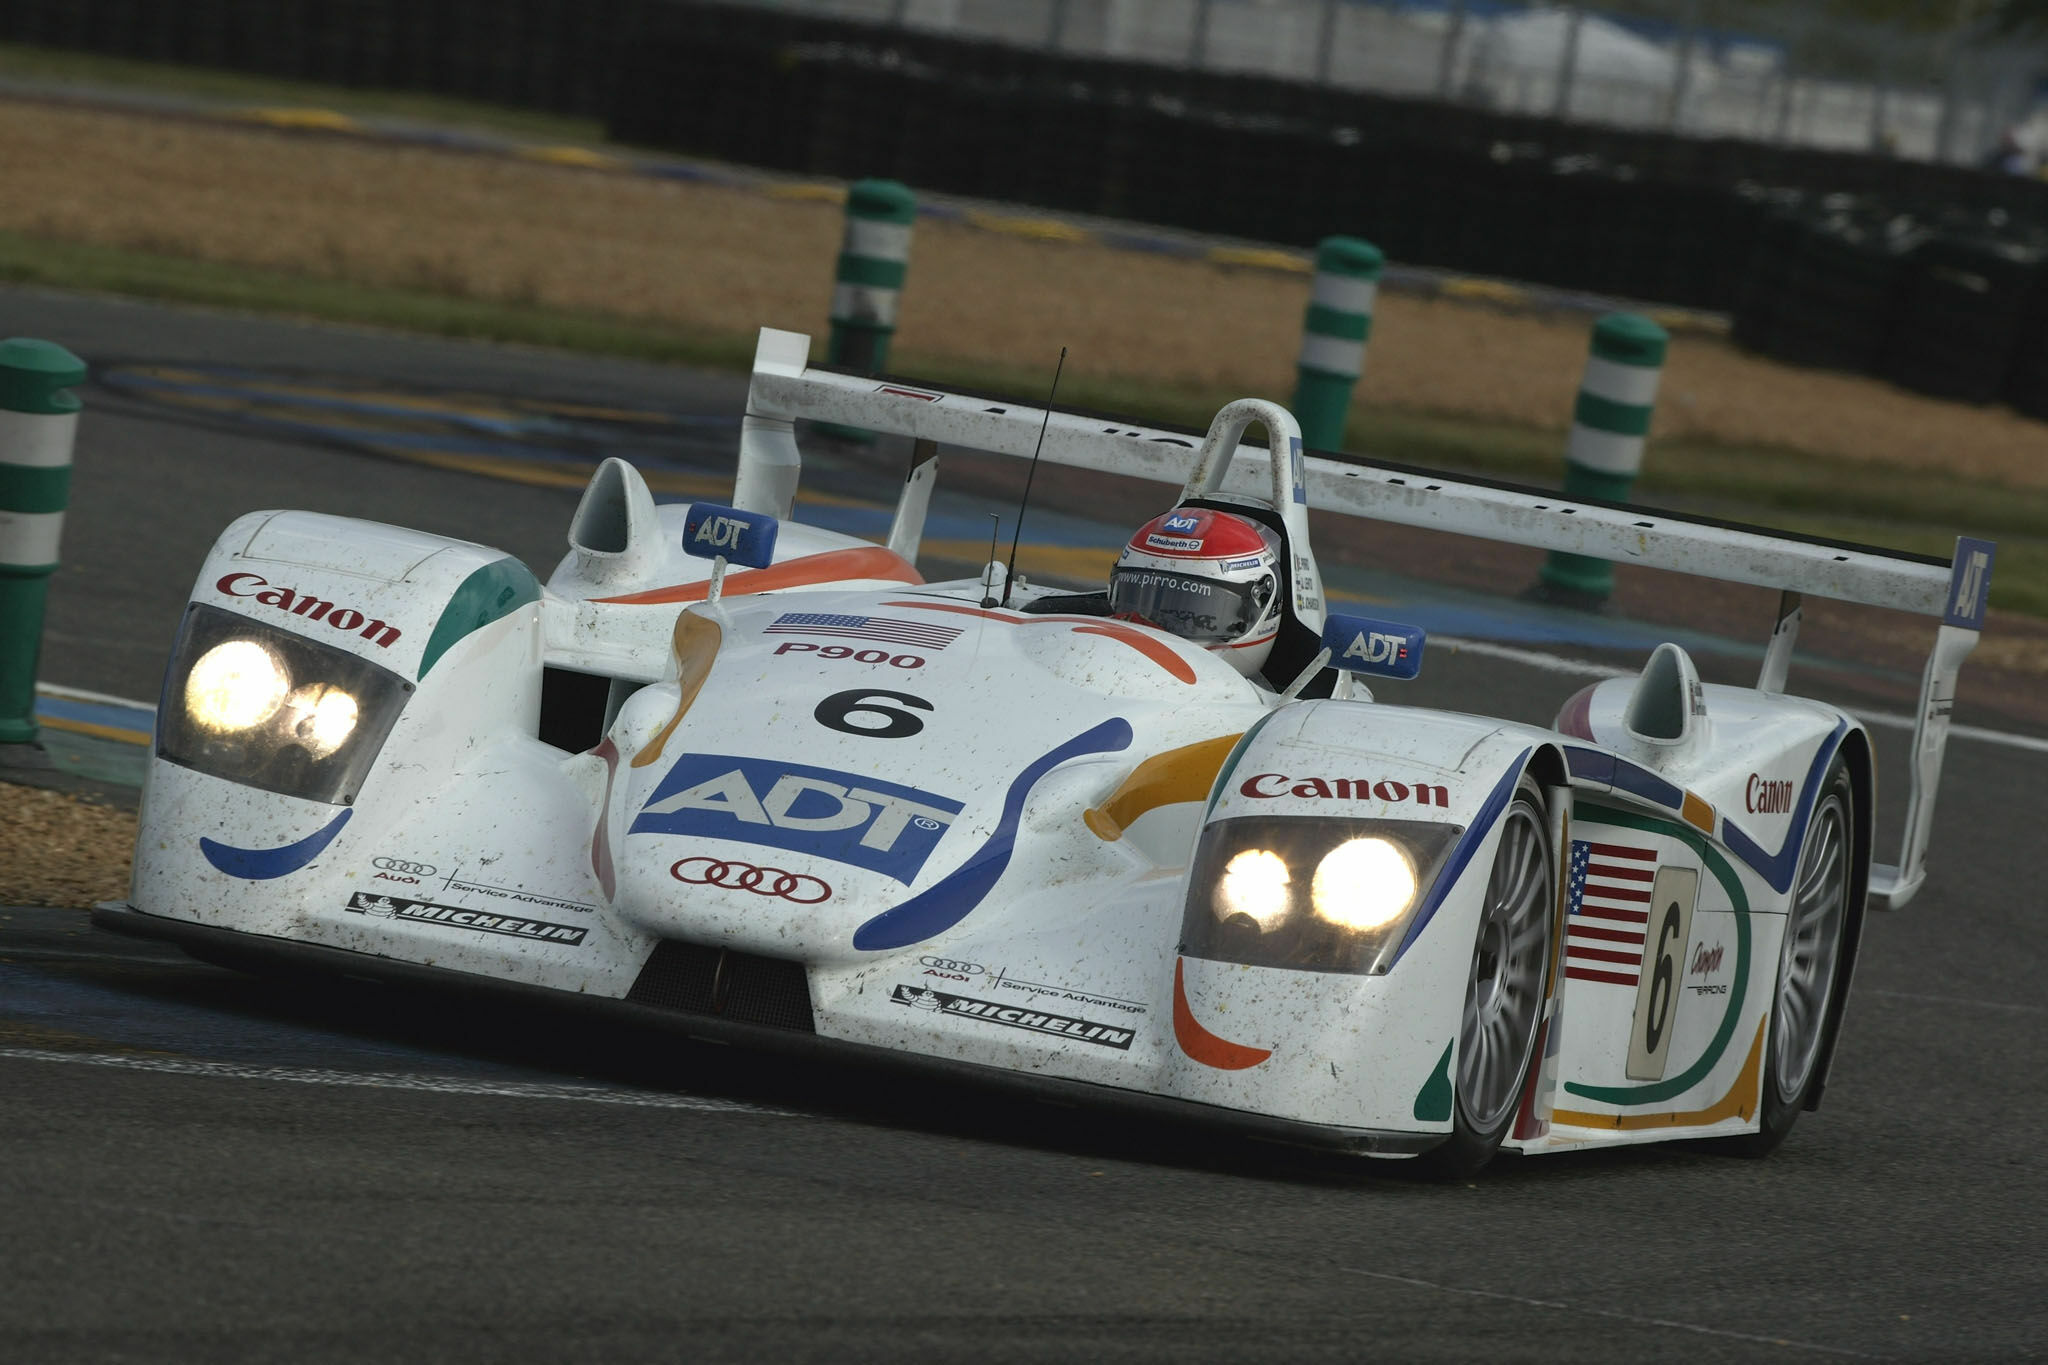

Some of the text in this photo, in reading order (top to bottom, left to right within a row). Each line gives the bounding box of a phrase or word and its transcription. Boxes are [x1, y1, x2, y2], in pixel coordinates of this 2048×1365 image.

[695, 515, 751, 550] ADT
[1164, 515, 1198, 532] ADT
[1148, 535, 1188, 549] Schuberth
[1118, 571, 1211, 597] www.pirro.com
[216, 572, 402, 649] Canon
[773, 642, 926, 669] P900
[1343, 631, 1407, 666] ADT
[814, 688, 934, 739] 6
[1239, 773, 1449, 808] Canon
[1746, 772, 1793, 814] Canon
[373, 872, 421, 886] Audi
[451, 882, 595, 914] Service Advantage
[401, 904, 584, 941] MICHELIN
[922, 969, 970, 983] Audi
[1646, 901, 1680, 1054] 6
[1001, 981, 1147, 1014] Service Advantage
[947, 999, 1132, 1045] MICHELIN
